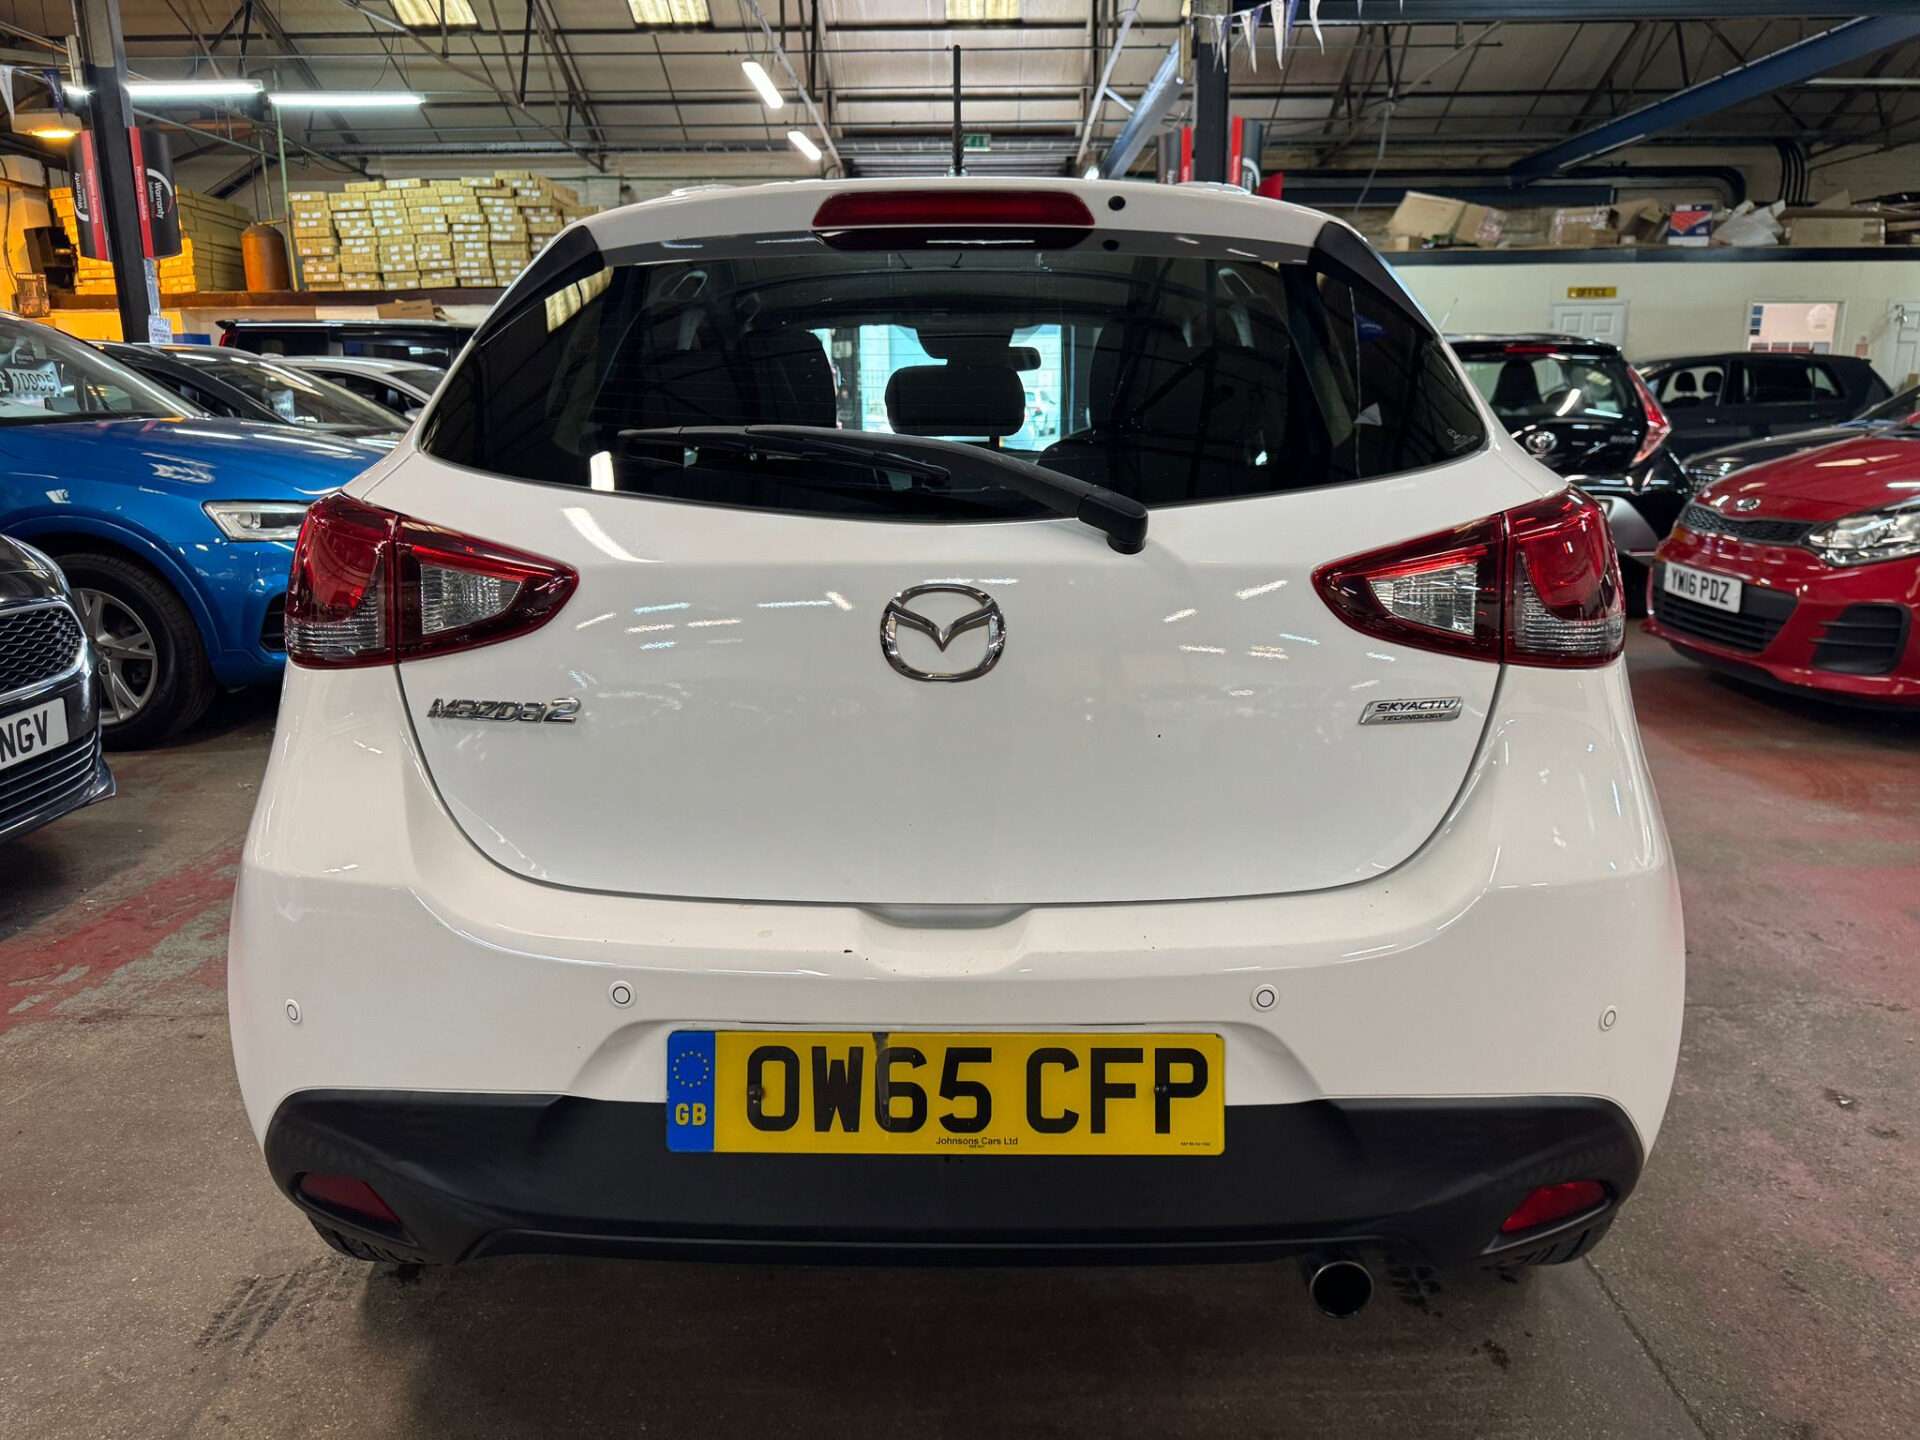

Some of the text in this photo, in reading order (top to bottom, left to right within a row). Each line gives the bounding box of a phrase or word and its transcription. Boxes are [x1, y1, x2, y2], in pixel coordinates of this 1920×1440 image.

[154, 181, 165, 220] Warranty
[1700, 577, 1730, 604] PDZ
[1375, 699, 1457, 713] SKYACTIV
[746, 1045, 1209, 1134] OW65 CFP
[675, 1103, 708, 1126] GB
[935, 1135, 1019, 1145] Johnsons Cars Ltd
